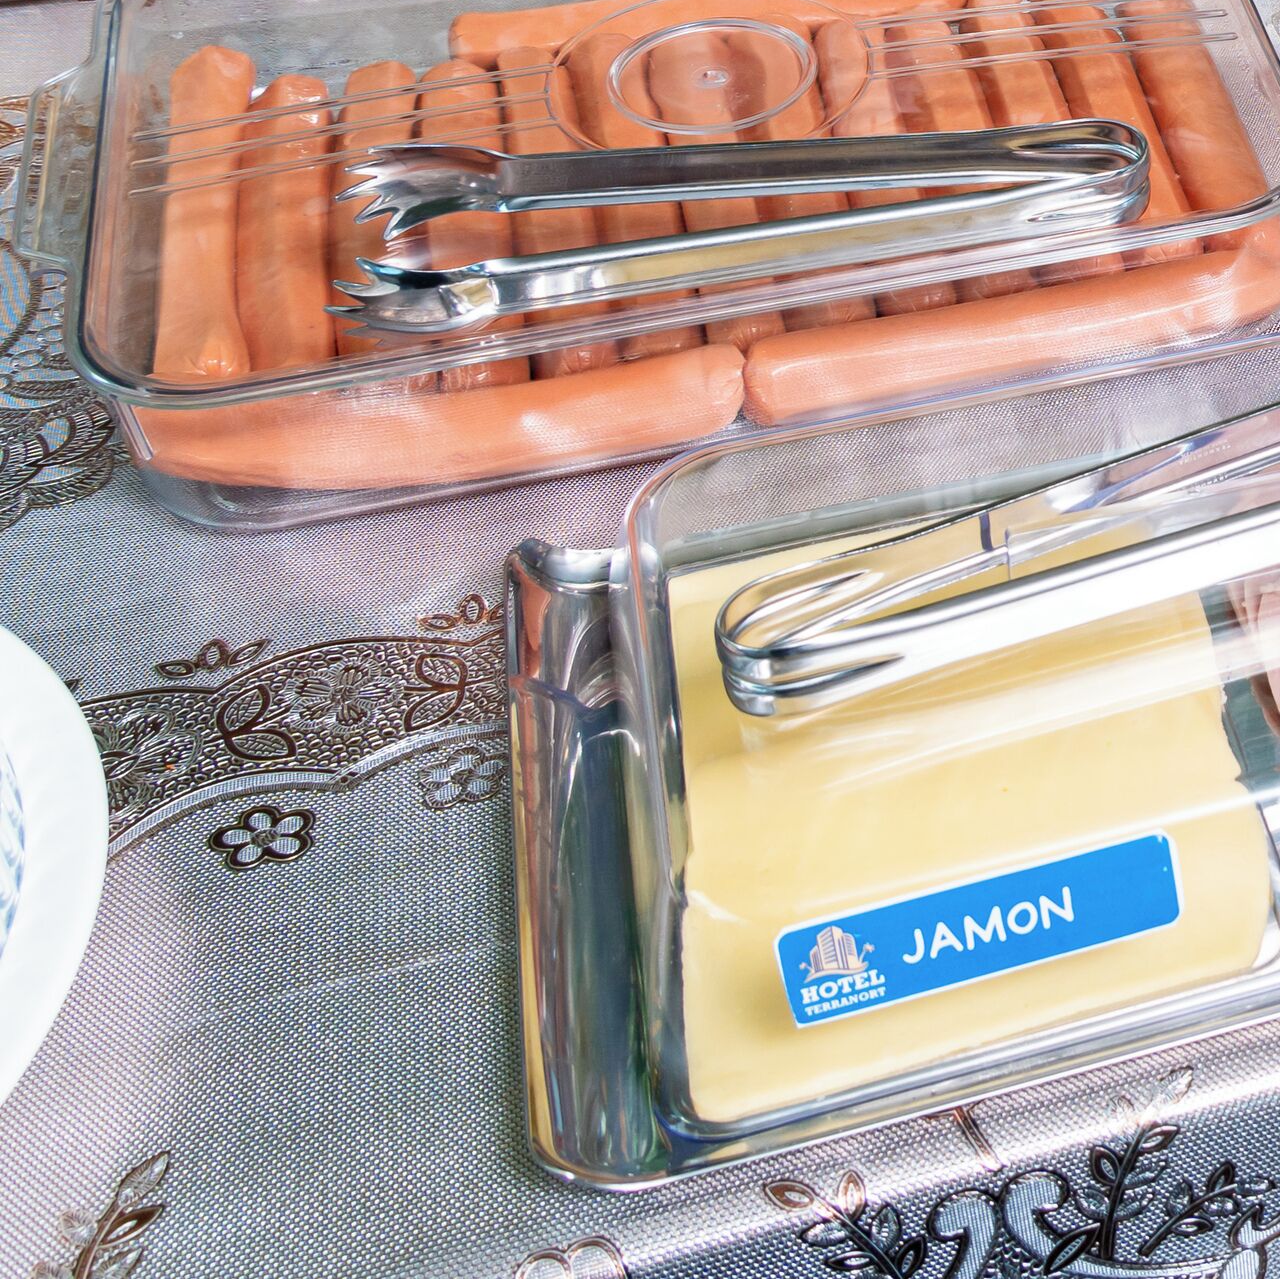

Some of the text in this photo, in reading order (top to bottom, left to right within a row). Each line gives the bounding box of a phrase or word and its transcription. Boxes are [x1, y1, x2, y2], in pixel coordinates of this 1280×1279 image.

[902, 886, 1075, 964] JAMON
[800, 969, 885, 1005] HOTEL
[805, 986, 886, 1016] TERRANORT
